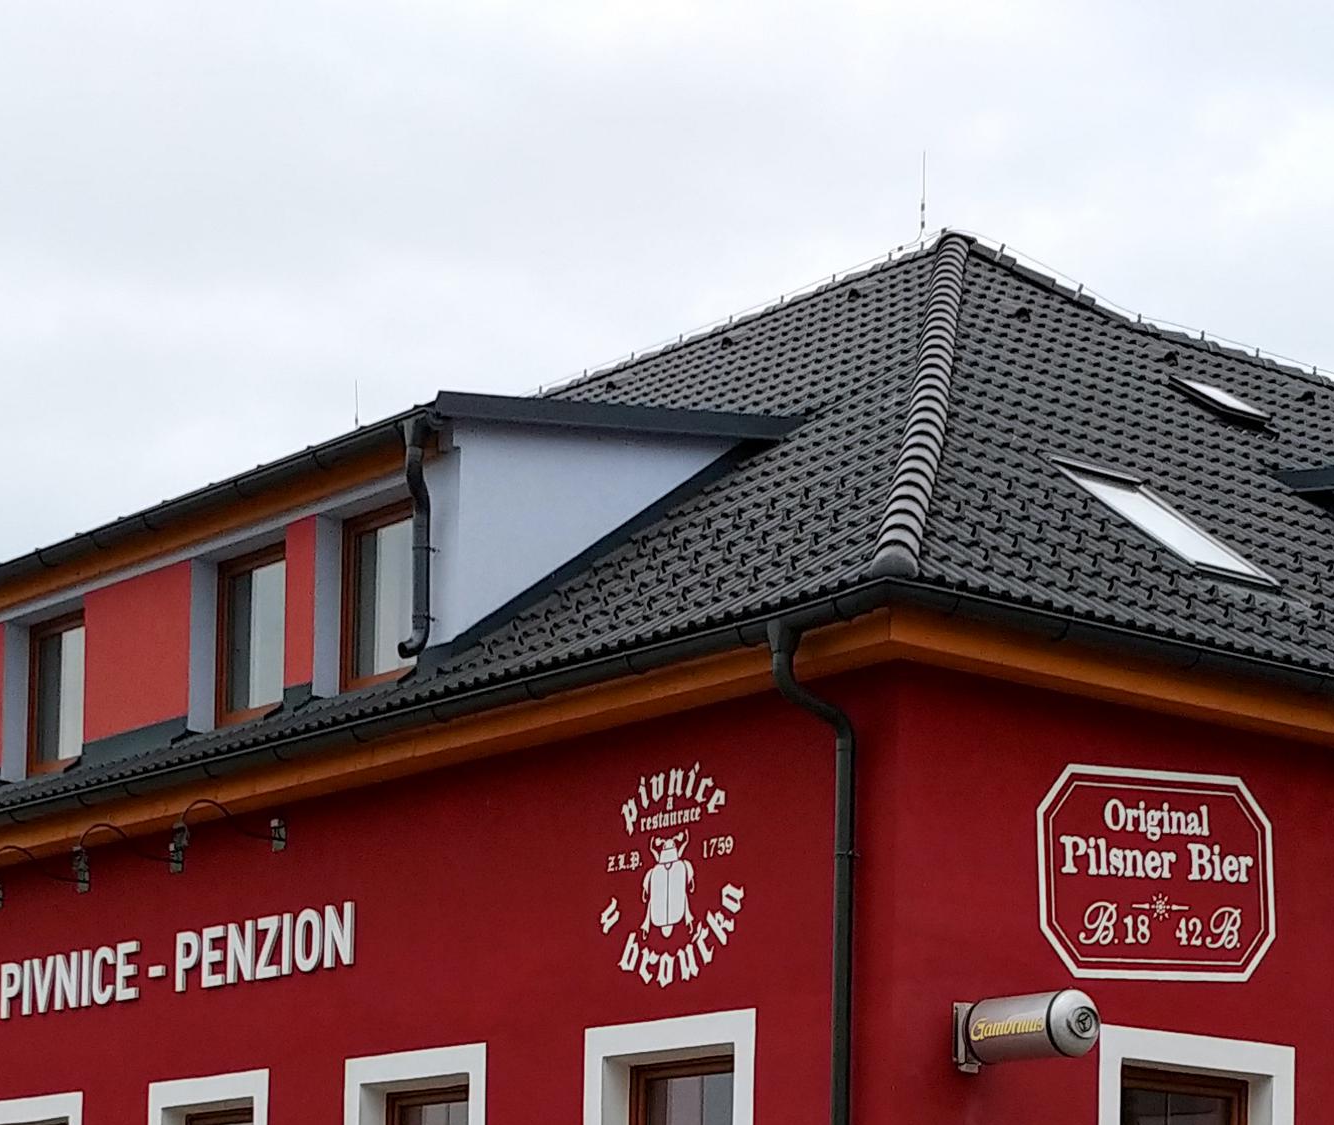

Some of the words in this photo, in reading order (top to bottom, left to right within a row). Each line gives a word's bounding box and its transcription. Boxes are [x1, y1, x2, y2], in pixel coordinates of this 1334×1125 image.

[621, 761, 726, 836] pivnice
[640, 806, 701, 832] restaurace
[1104, 799, 1209, 841] Original
[702, 836, 734, 858] 1759
[1060, 833, 1176, 878] Pilsner
[1187, 844, 1253, 882] Bier
[1124, 915, 1150, 943] 18
[1176, 918, 1201, 945] 42
[0, 941, 139, 1018] PIVNICE
[176, 902, 354, 991] PENZION
